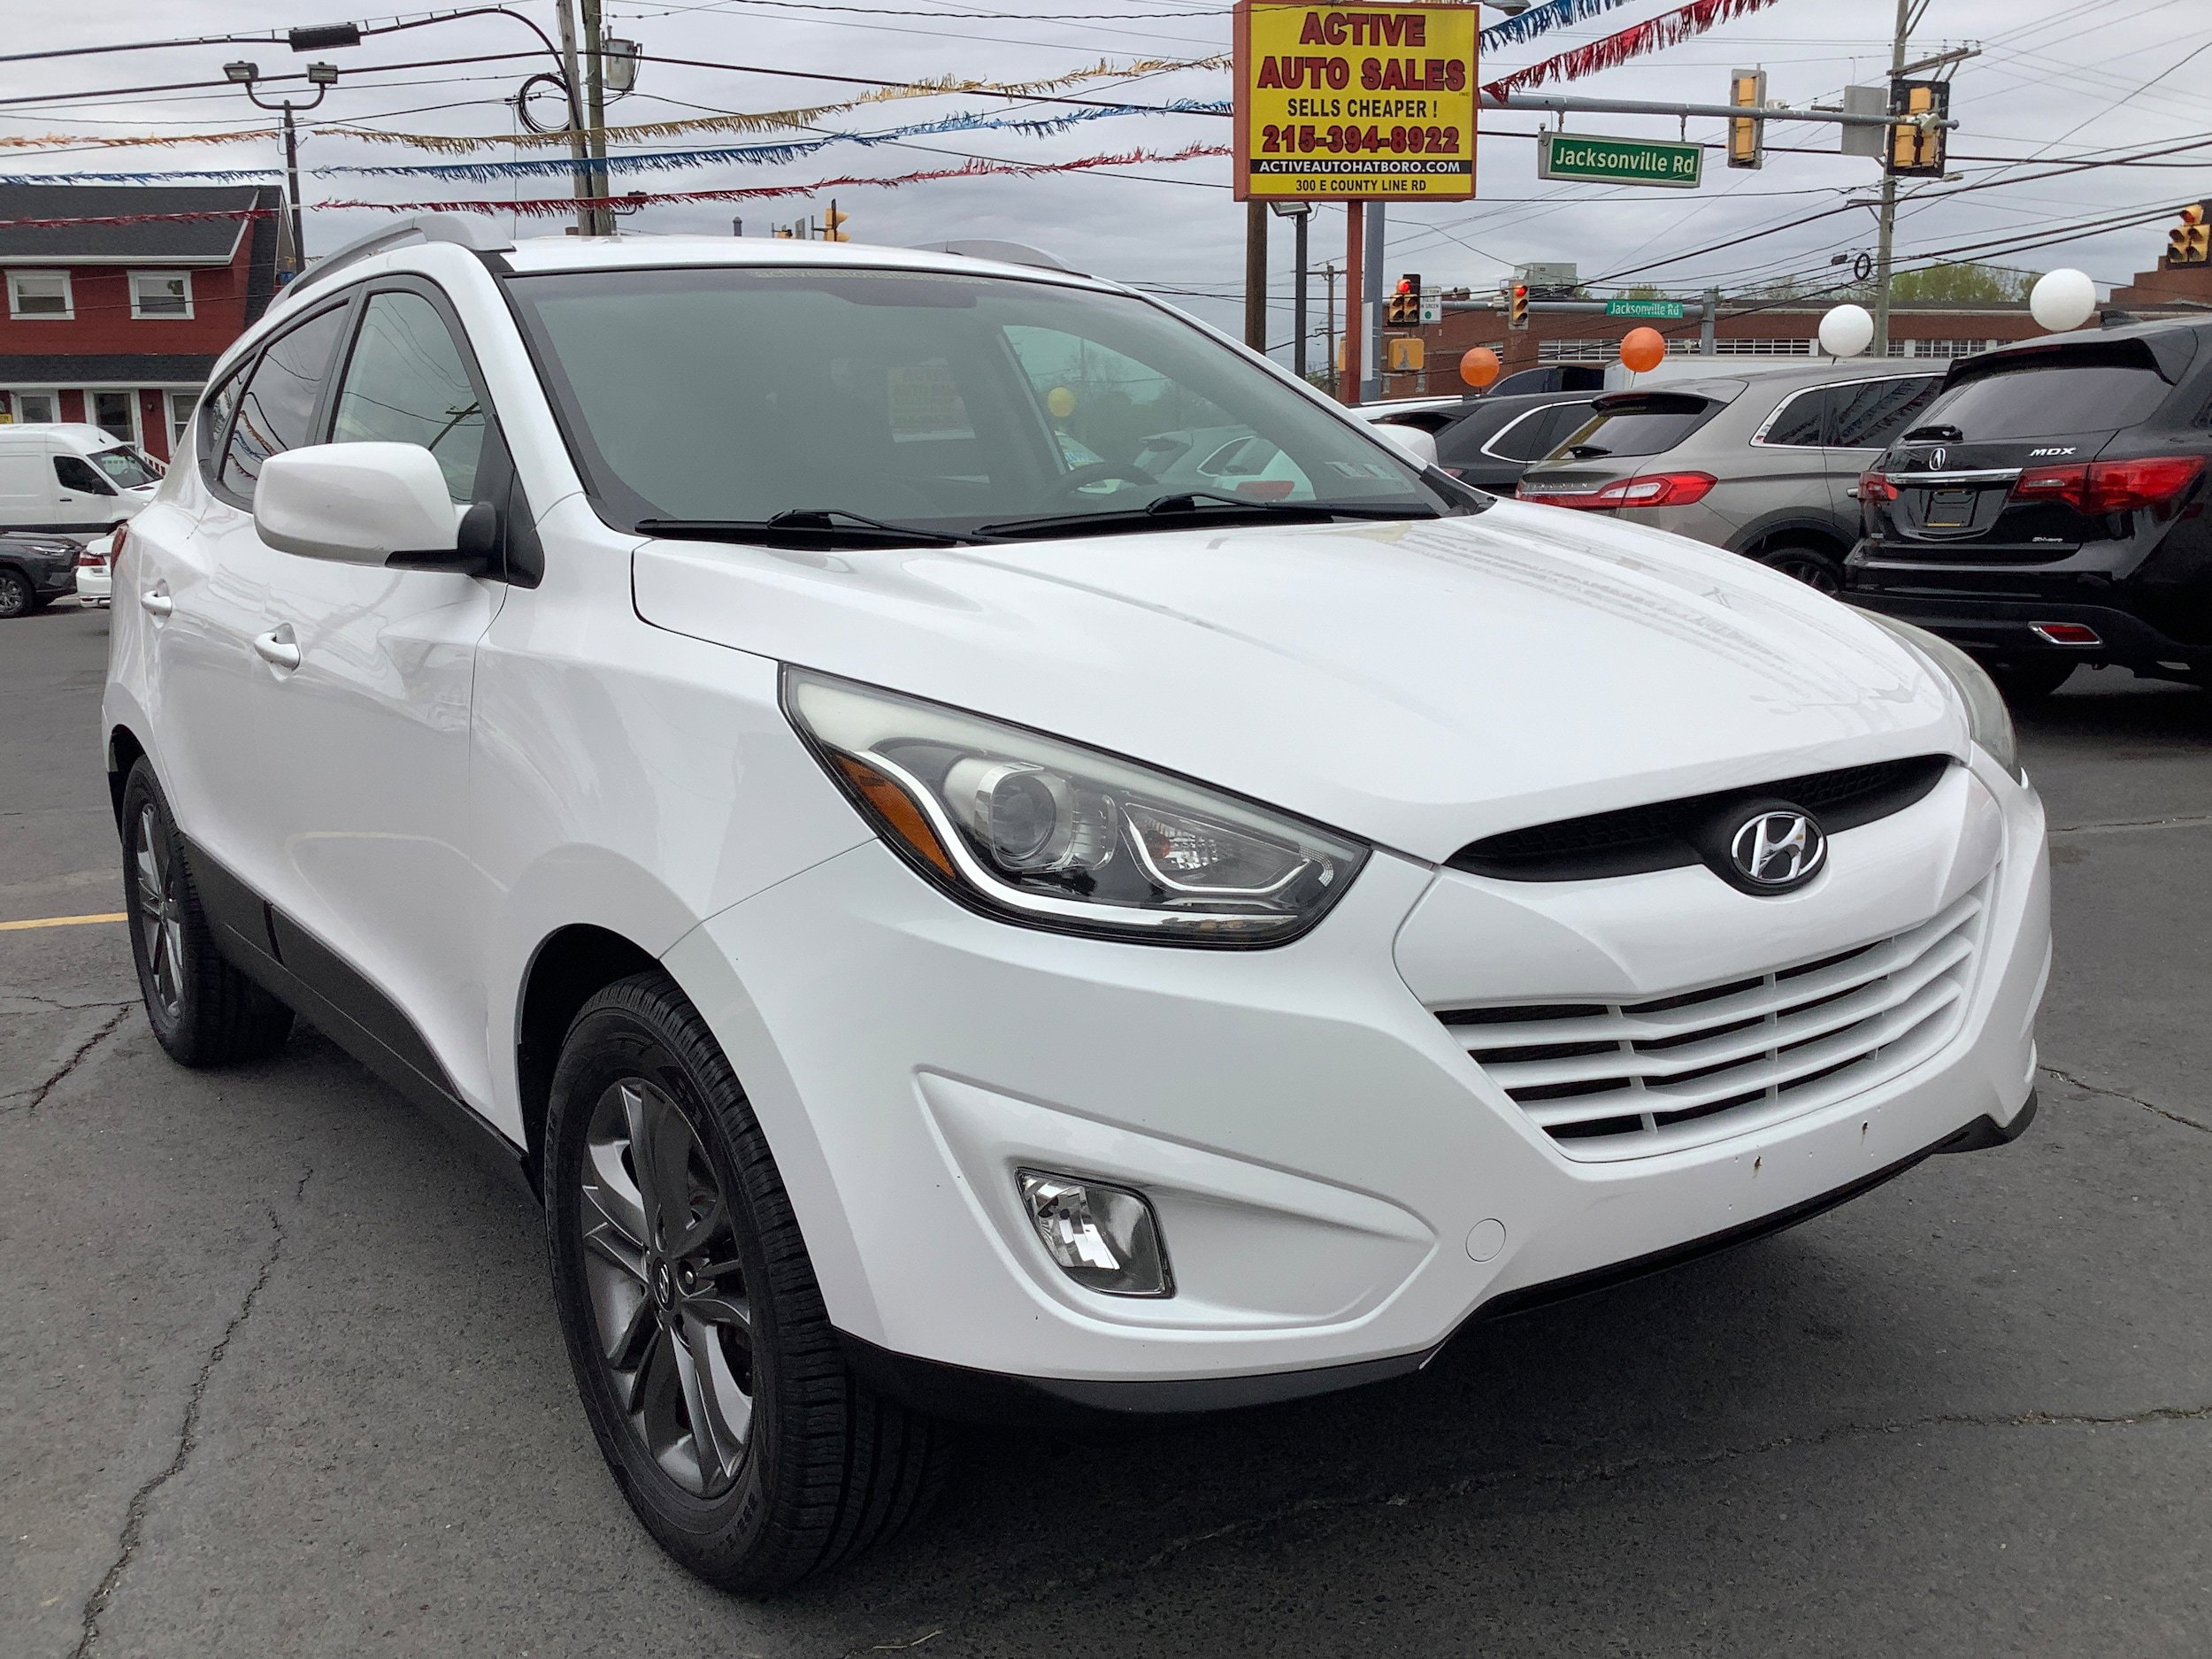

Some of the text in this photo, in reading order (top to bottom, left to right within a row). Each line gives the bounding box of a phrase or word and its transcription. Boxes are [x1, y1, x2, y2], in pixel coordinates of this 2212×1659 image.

[1299, 12, 1426, 47] ACTIVE
[1257, 56, 1466, 92] AUTO SALES
[1287, 98, 1340, 117] SELLS
[1348, 100, 1427, 118] CHEAPER
[1262, 125, 1460, 154] 215-394-8922
[1259, 160, 1461, 173] ACTIVEAUTOHATBORO.COM
[1555, 147, 1695, 173] Jacksonville Rd
[1296, 180, 1426, 191] 300 E COUNTY LINE RD
[1610, 303, 1679, 316] Jacksonville Rd
[2029, 447, 2077, 457] MDX
